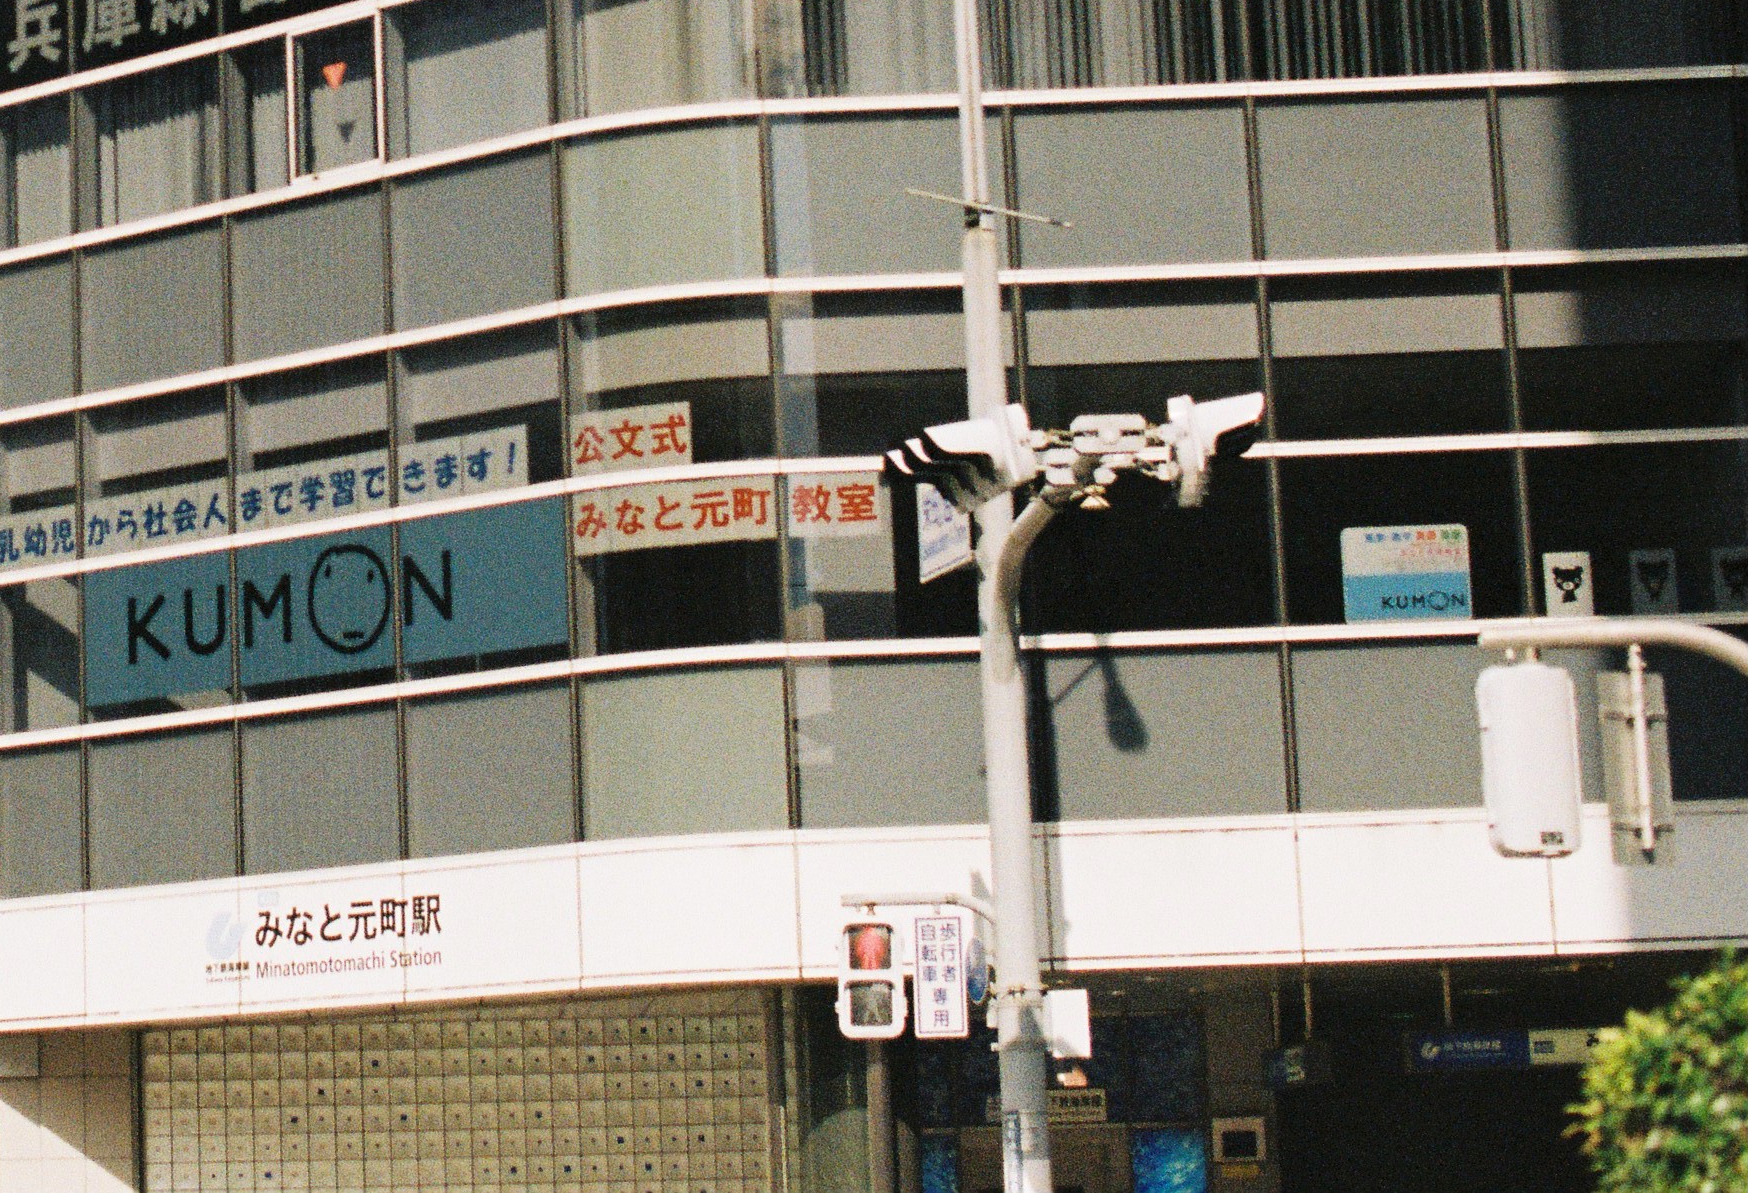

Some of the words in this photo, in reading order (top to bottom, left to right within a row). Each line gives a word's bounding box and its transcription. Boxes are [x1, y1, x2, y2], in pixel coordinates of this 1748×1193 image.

[573, 413, 688, 465] 公文式
[127, 543, 453, 665] KUMON
[1381, 590, 1466, 611] KUMON
[254, 894, 443, 948] みなと元町駅
[255, 950, 386, 979] Minatomotomachi
[389, 948, 443, 969] Station
[920, 923, 938, 982] 自転車
[940, 923, 957, 983] 歩行者
[933, 987, 950, 1027] 専用
